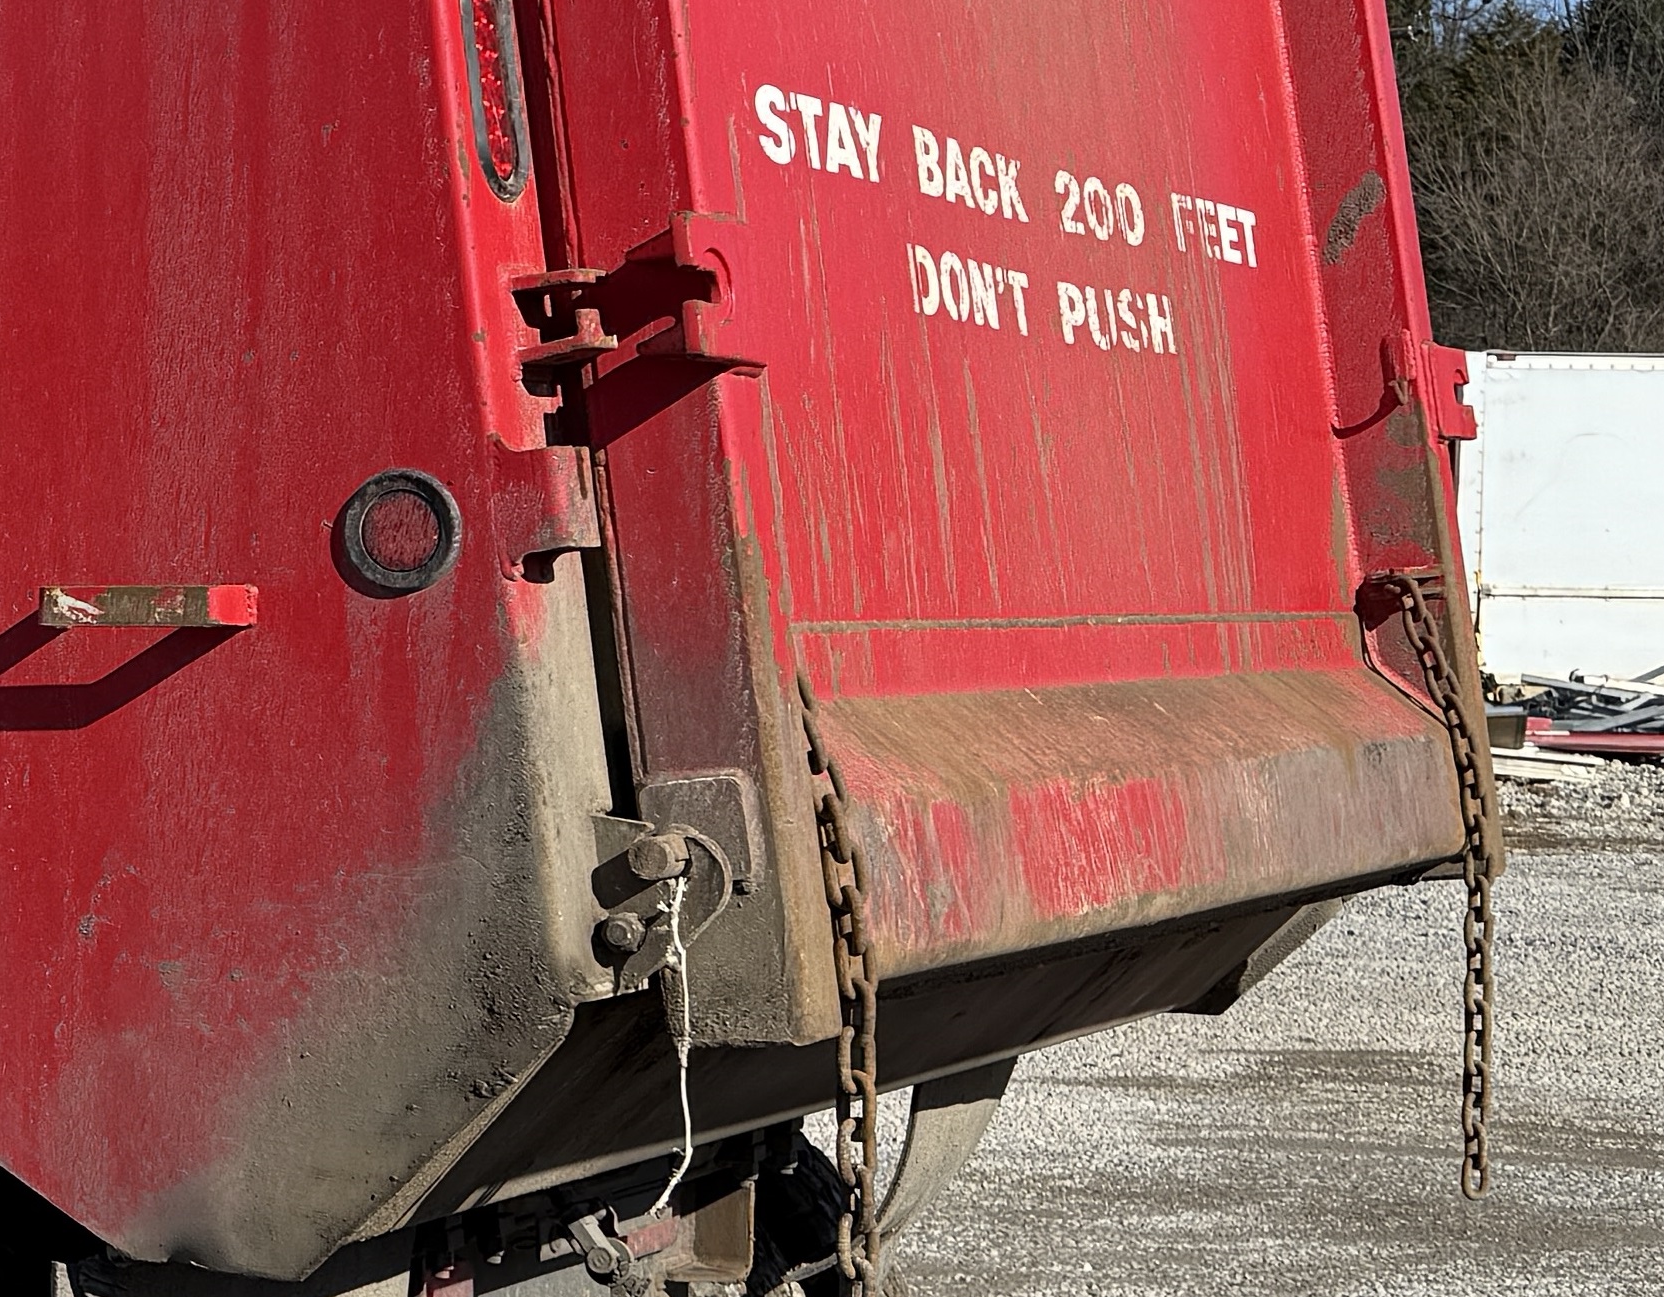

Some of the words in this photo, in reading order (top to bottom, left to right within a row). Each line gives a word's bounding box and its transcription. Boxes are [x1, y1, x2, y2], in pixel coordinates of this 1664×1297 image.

[754, 84, 882, 183] STAY
[911, 124, 1029, 223] BACK
[1054, 170, 1145, 247] 200
[1171, 191, 1258, 268] FEET
[906, 242, 1028, 336] DON'T
[1057, 281, 1177, 354] PUSH
